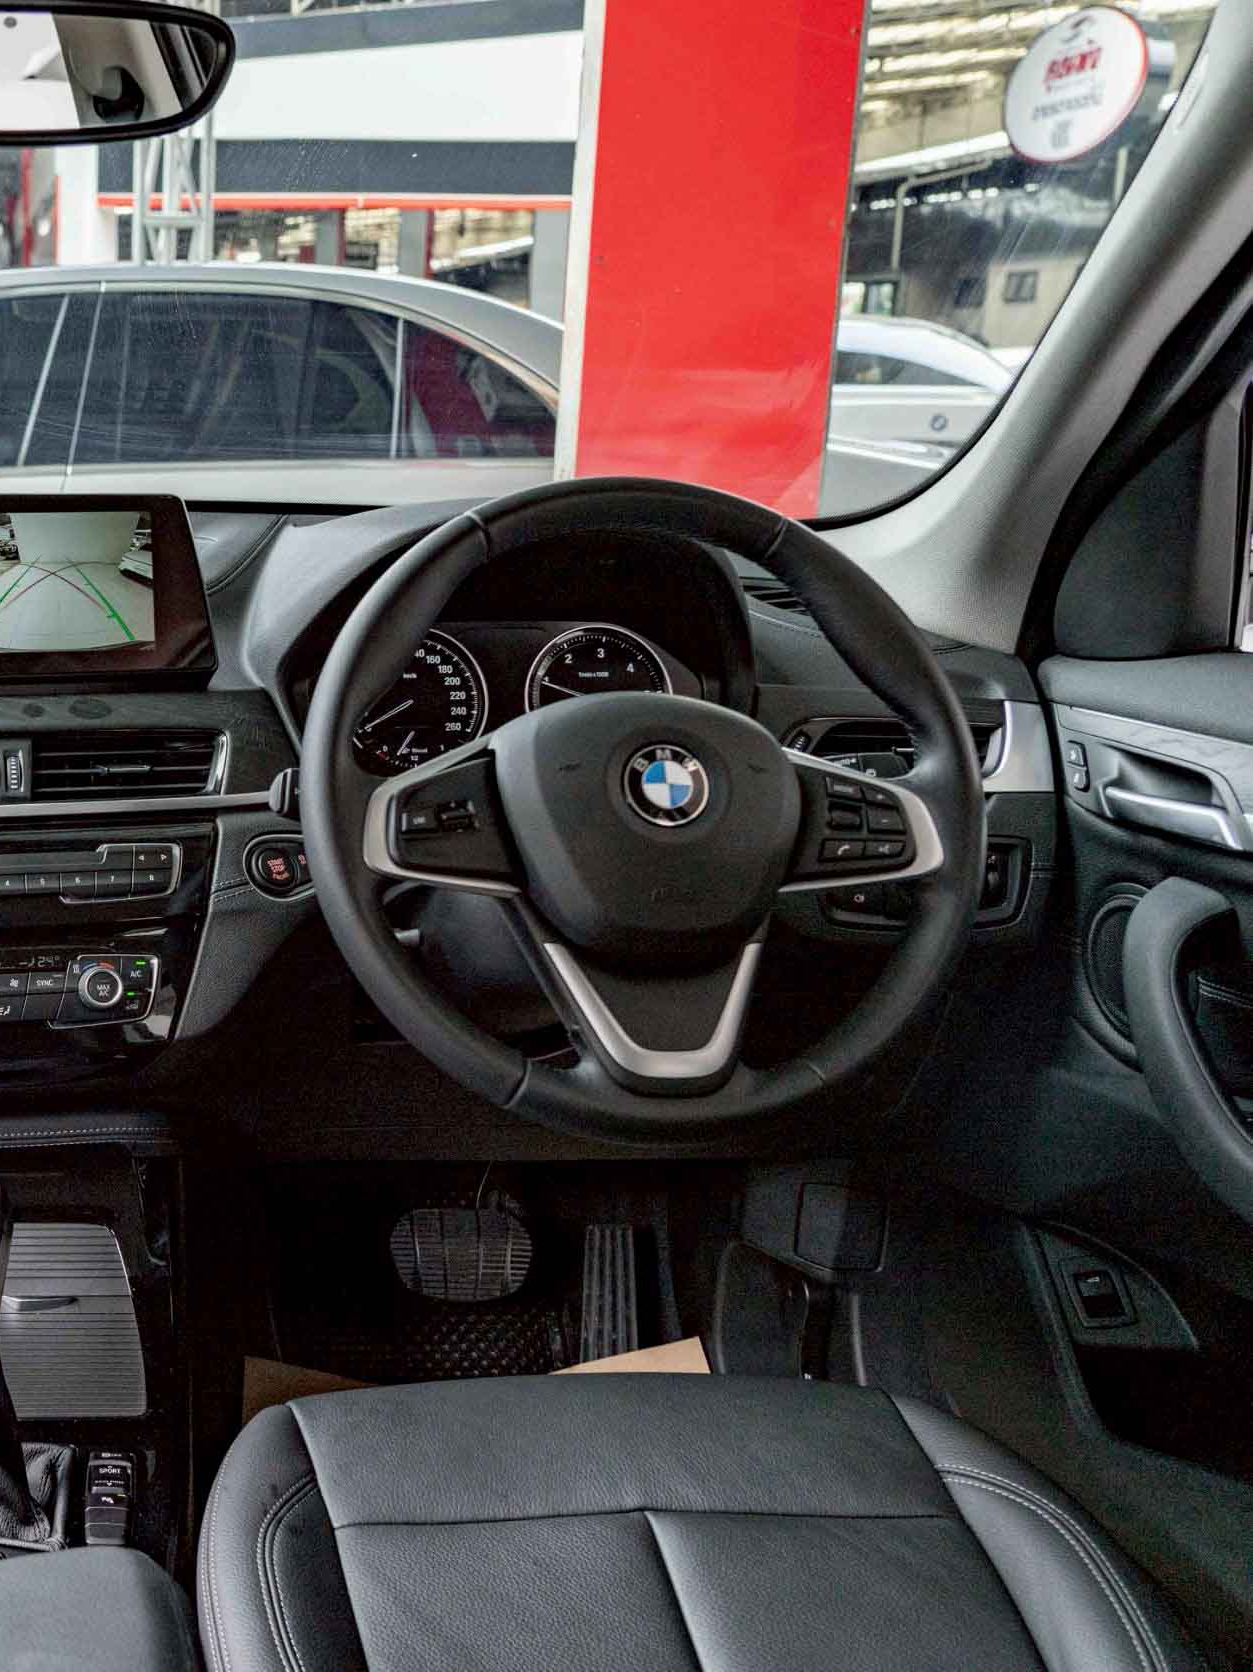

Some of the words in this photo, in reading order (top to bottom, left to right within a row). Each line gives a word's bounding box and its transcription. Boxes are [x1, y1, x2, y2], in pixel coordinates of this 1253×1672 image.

[597, 648, 605, 658] 3
[564, 654, 573, 664] 2
[437, 665, 453, 674] 180
[626, 663, 635, 673] 4
[444, 677, 461, 686] 200
[450, 691, 466, 700] 220
[451, 707, 467, 715] 240
[445, 722, 462, 732] 260
[633, 748, 701, 773] BMW
[130, 970, 142, 979] A/C
[36, 978, 54, 987] SYNC
[97, 983, 111, 991] MAX
